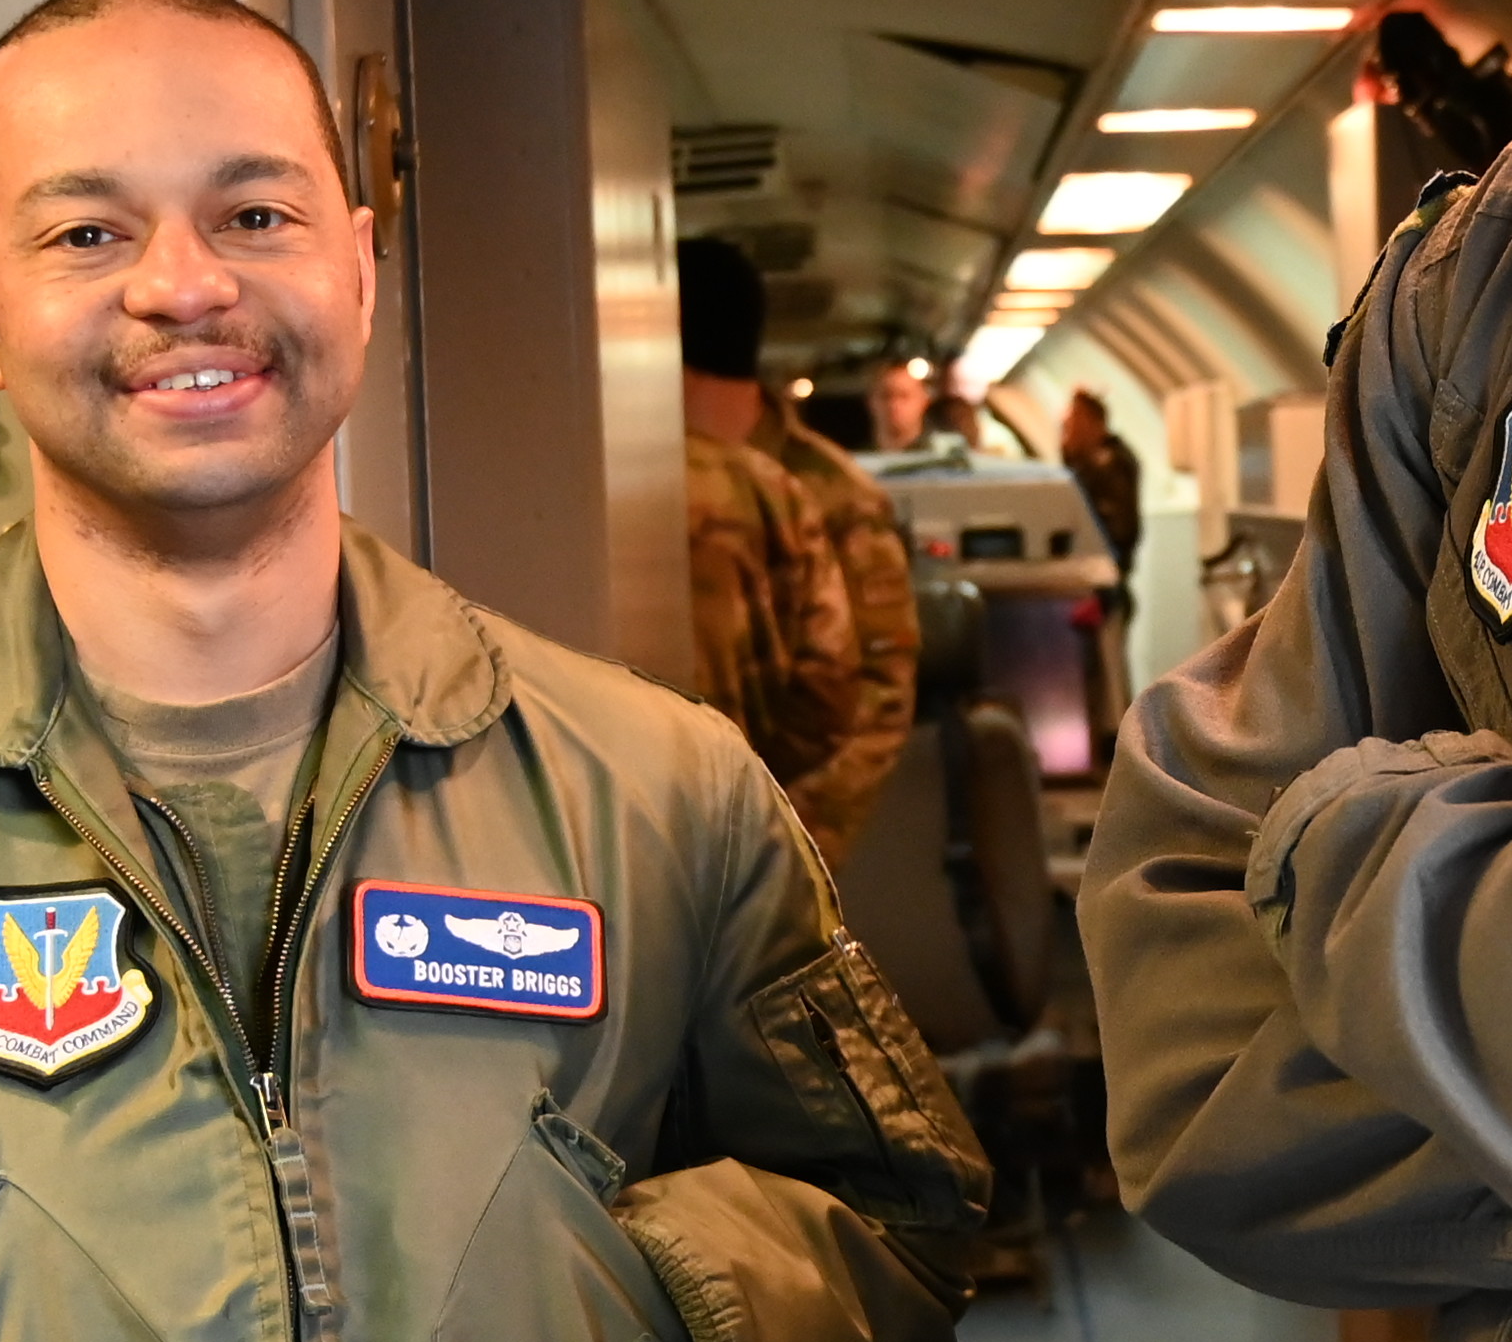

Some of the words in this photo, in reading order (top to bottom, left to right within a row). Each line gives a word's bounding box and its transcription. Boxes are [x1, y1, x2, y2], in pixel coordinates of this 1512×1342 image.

[414, 959, 506, 989] BOOSTER
[512, 969, 583, 998] BRIGGS
[62, 1000, 139, 1054] COMMAND
